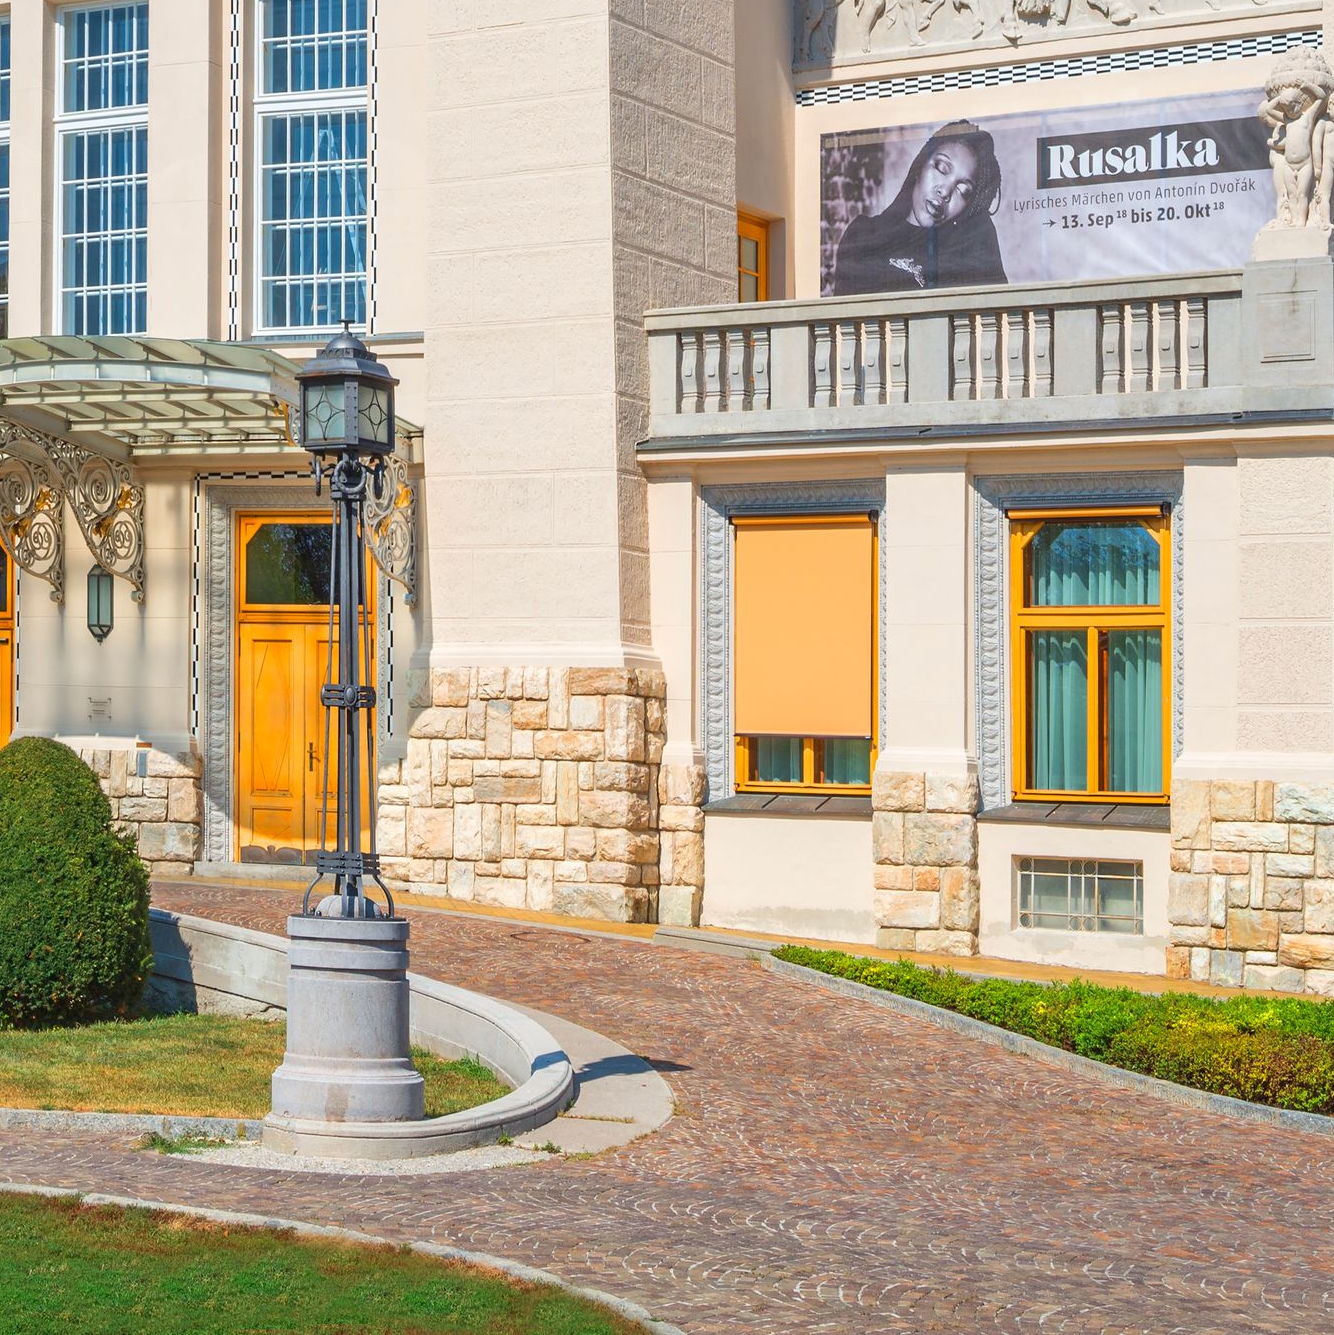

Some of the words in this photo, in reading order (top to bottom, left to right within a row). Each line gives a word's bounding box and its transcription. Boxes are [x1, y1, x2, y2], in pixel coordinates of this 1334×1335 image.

[1047, 130, 1220, 181] Rusalka
[1013, 195, 1068, 214] Lyrisches
[1071, 190, 1124, 207] Märchen
[1128, 189, 1151, 202] von
[1155, 180, 1206, 200] Antonín
[1210, 177, 1256, 195] Dvořák
[1061, 214, 1084, 230] 13.
[1087, 213, 1114, 228] Sep
[1131, 207, 1153, 224] bis
[1157, 206, 1180, 221] 20.
[1184, 202, 1211, 220] Okt
